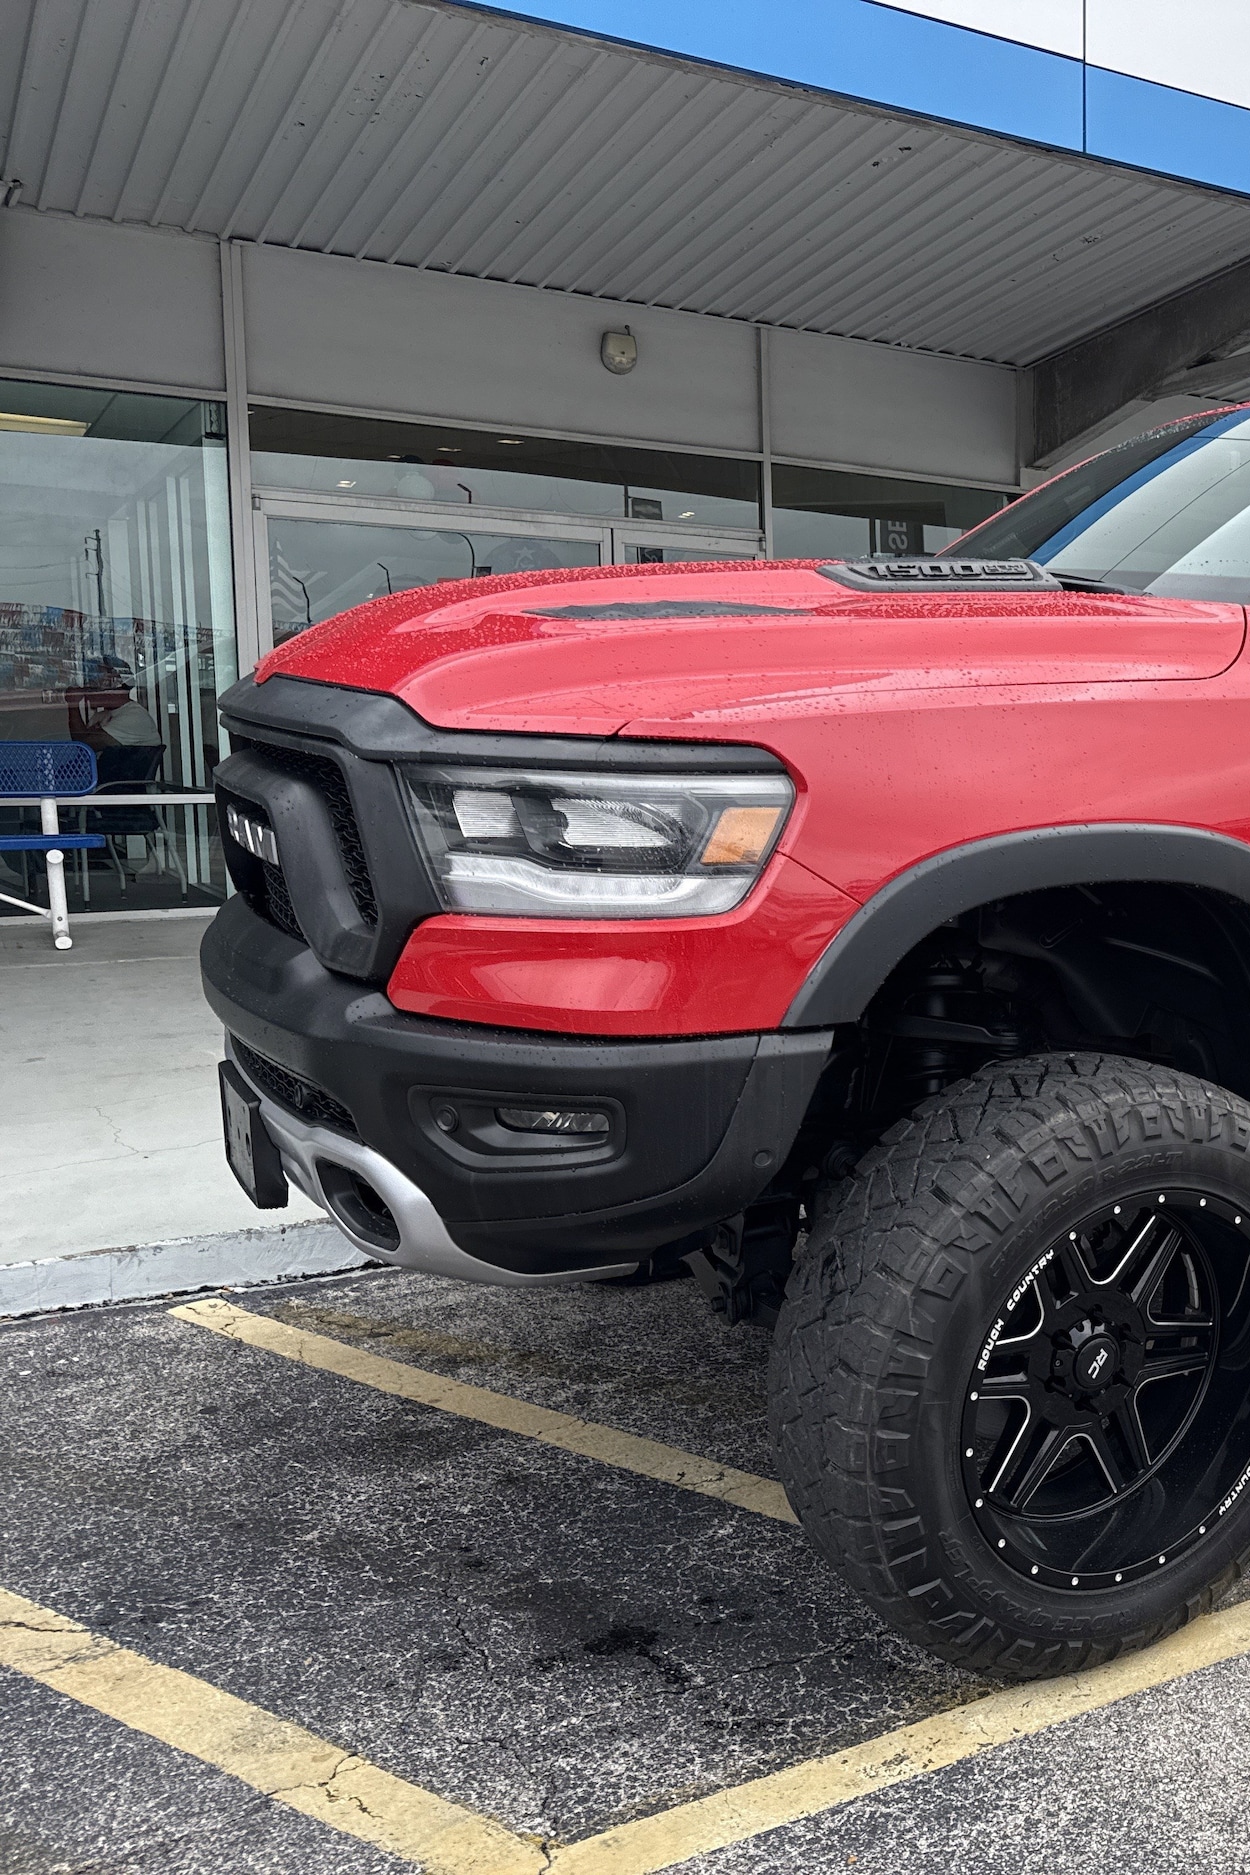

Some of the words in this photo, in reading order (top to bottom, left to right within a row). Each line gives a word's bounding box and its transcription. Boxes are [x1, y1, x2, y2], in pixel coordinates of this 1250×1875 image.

[868, 560, 981, 579] 1500
[226, 803, 279, 866] RAM
[977, 1318, 1005, 1371] ROUGH
[1006, 1248, 1054, 1312] COUNTRY
[1087, 1347, 1109, 1379] RC
